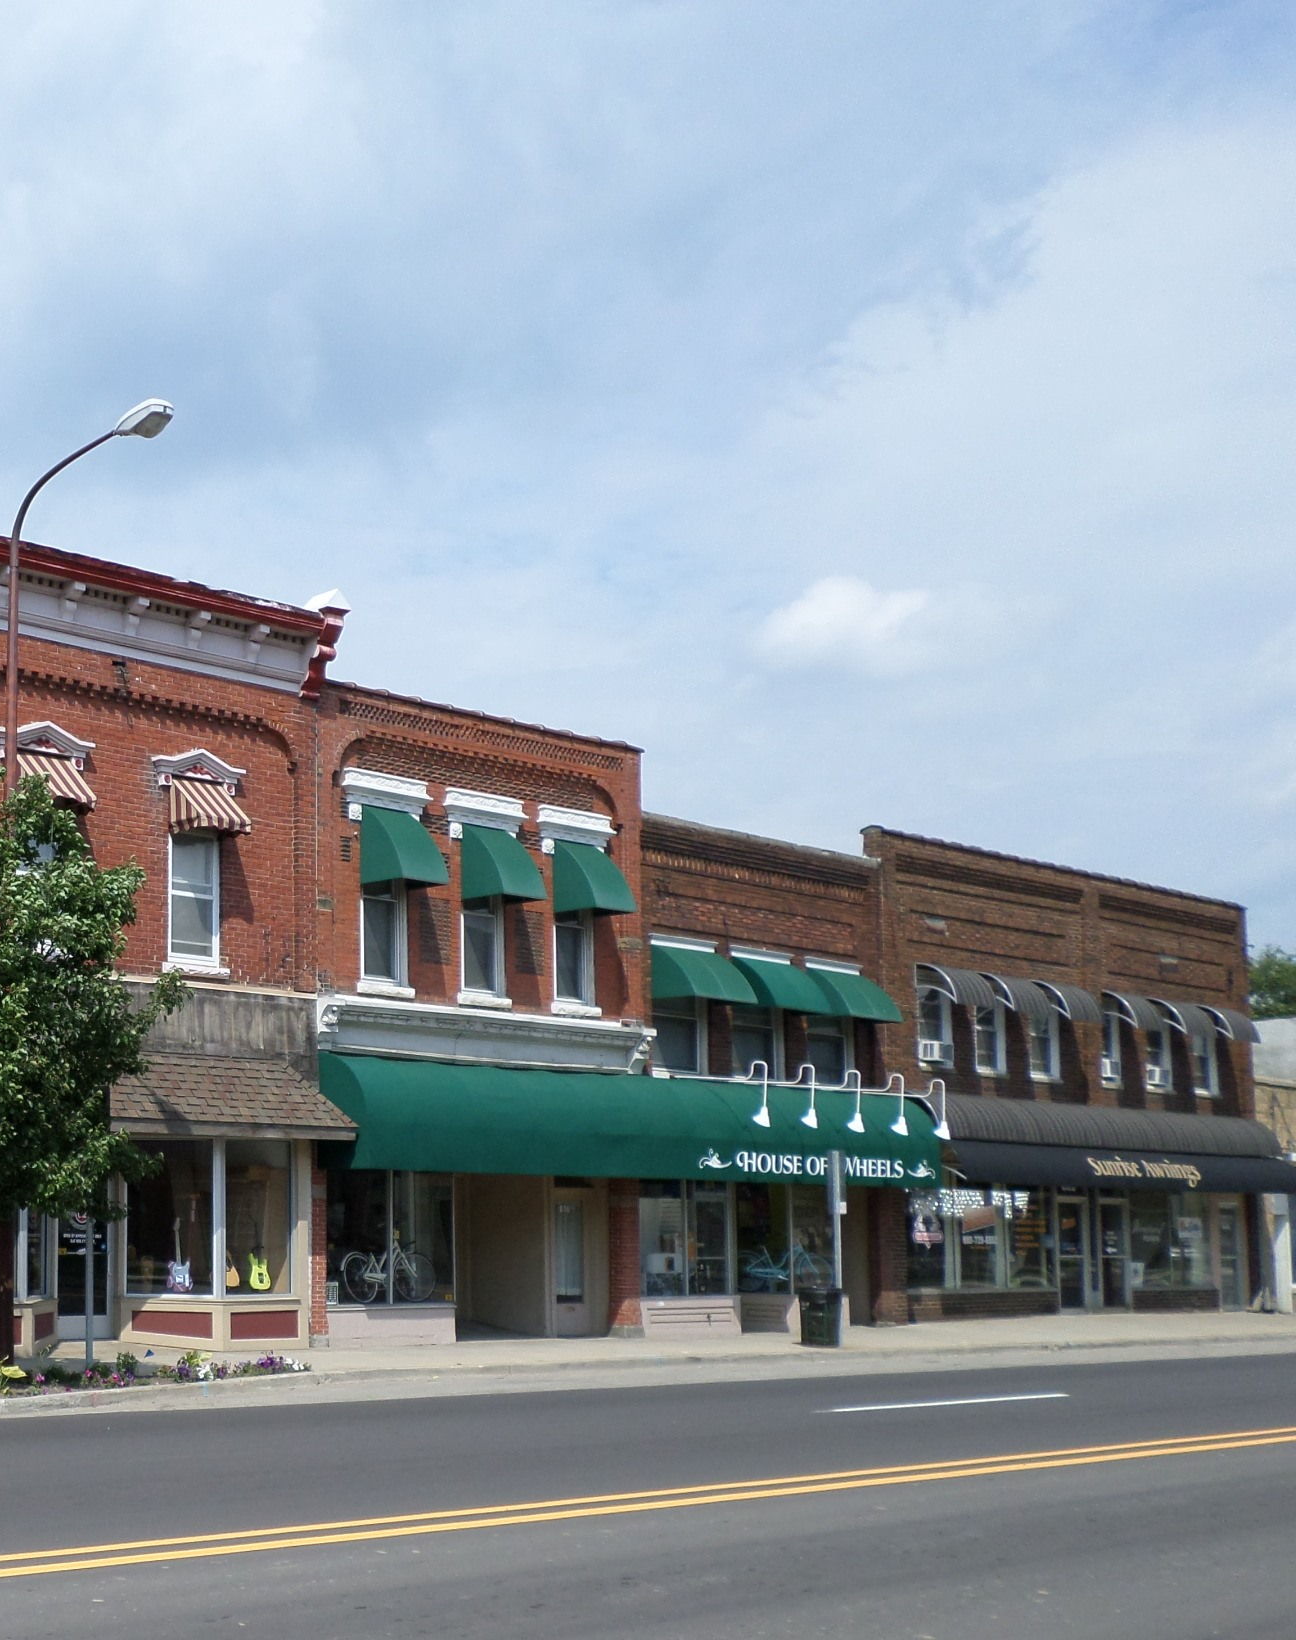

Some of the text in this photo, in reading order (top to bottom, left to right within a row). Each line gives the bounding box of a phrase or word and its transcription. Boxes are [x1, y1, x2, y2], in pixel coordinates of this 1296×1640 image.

[736, 1151, 802, 1175] HOUSE
[806, 1156, 829, 1176] OF
[1087, 1155, 1202, 1188] Sunrise Awnings
